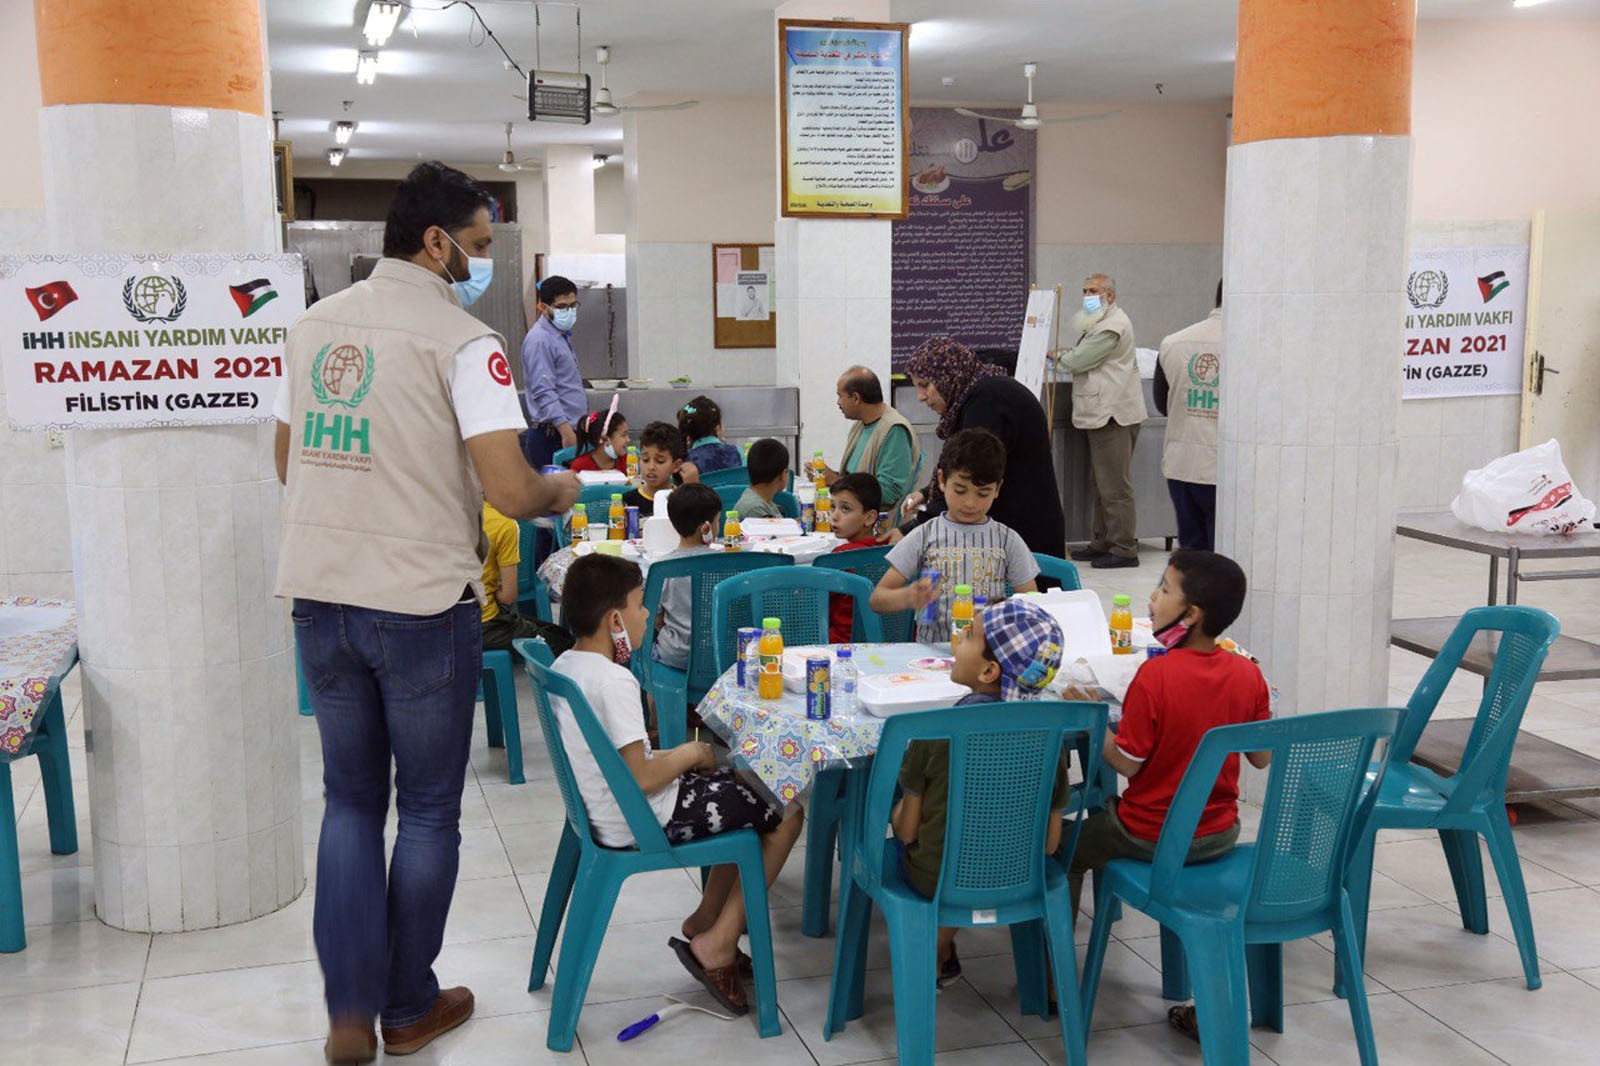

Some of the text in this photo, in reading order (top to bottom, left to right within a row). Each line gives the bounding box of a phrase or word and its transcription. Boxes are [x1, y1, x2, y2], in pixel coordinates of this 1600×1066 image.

[1417, 312, 1471, 328] YARDIM
[1474, 311, 1513, 326] VAKFI
[144, 328, 226, 347] YARDIM
[230, 327, 287, 345] VAKFI
[1404, 335, 1507, 356] ZAN 2021
[34, 356, 283, 384] RAMAZAN 2021
[1425, 364, 1488, 381] (GAZZE)
[65, 391, 259, 413] FİLİSTİN (GAZZE)
